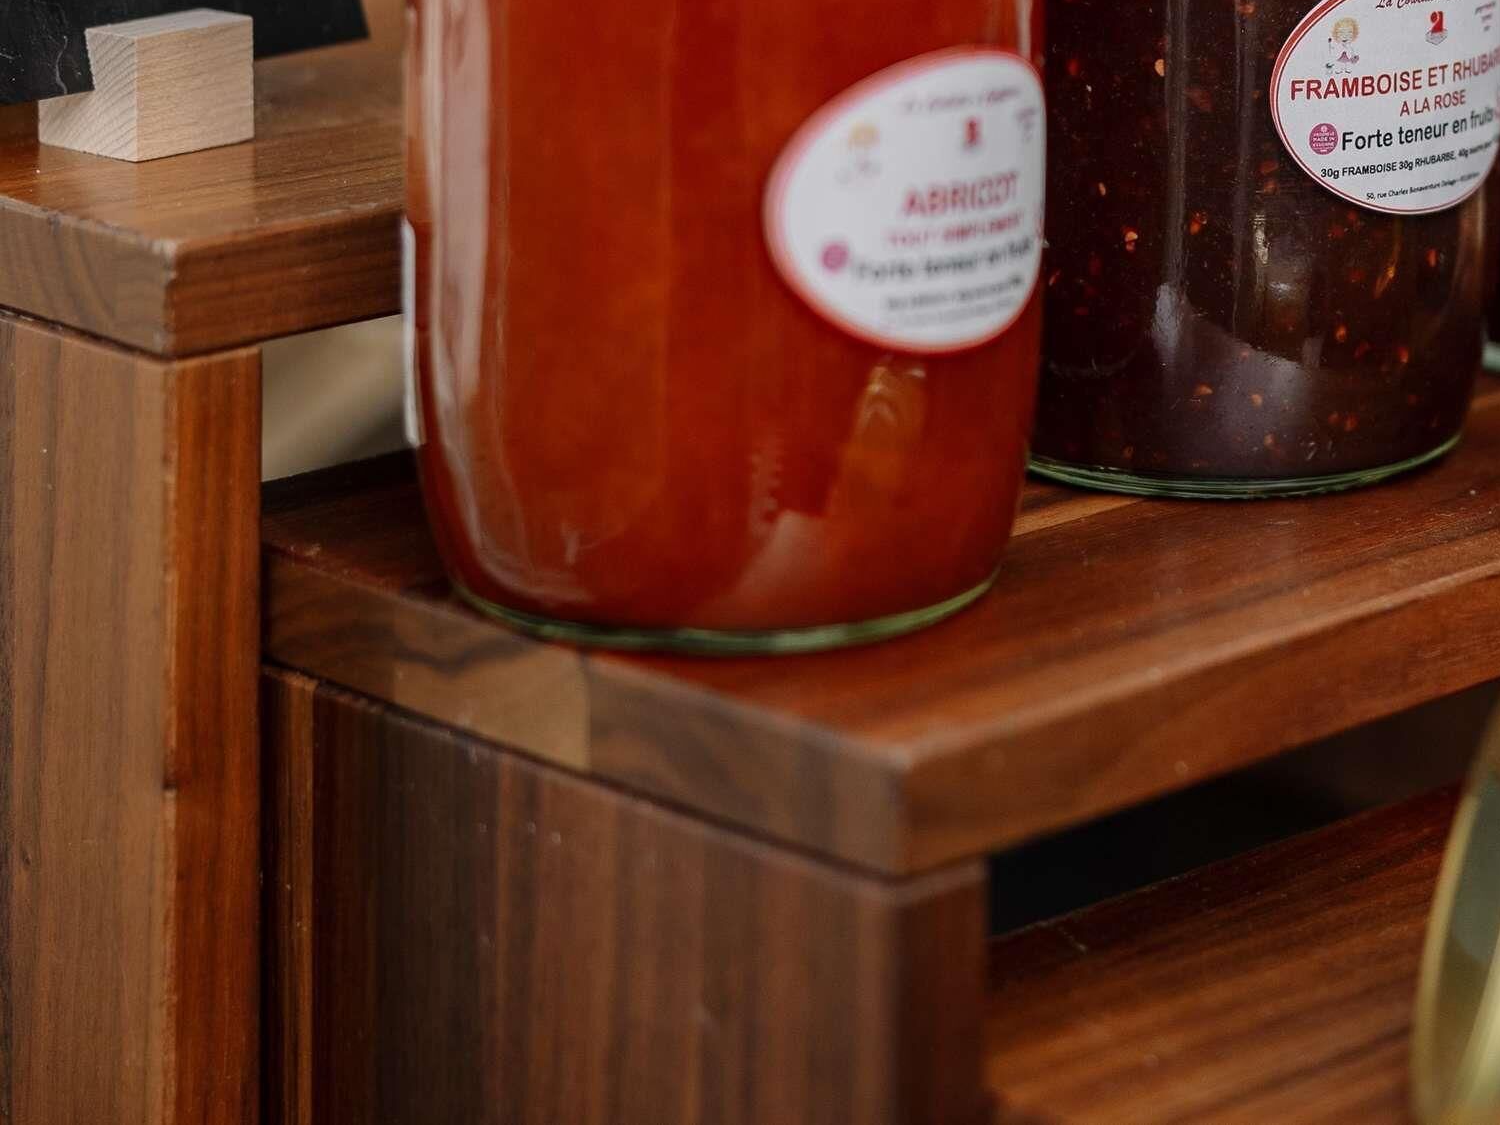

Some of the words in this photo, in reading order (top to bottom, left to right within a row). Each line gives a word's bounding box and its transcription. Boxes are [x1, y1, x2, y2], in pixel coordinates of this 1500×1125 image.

[1290, 70, 1423, 101] FRAMBOISE
[1428, 64, 1448, 88] ET
[1400, 100, 1410, 117] A
[1414, 96, 1431, 115] LA
[1434, 88, 1467, 111] ROSE
[1341, 128, 1394, 151] Forte
[1398, 122, 1449, 146] teneur
[1452, 117, 1468, 135] en
[1320, 167, 1340, 180] 30g
[1341, 161, 1398, 176] FRAMBOISE
[1399, 159, 1414, 171] 30g
[902, 170, 1019, 217] ABRICOT
[1377, 191, 1387, 200] rue
